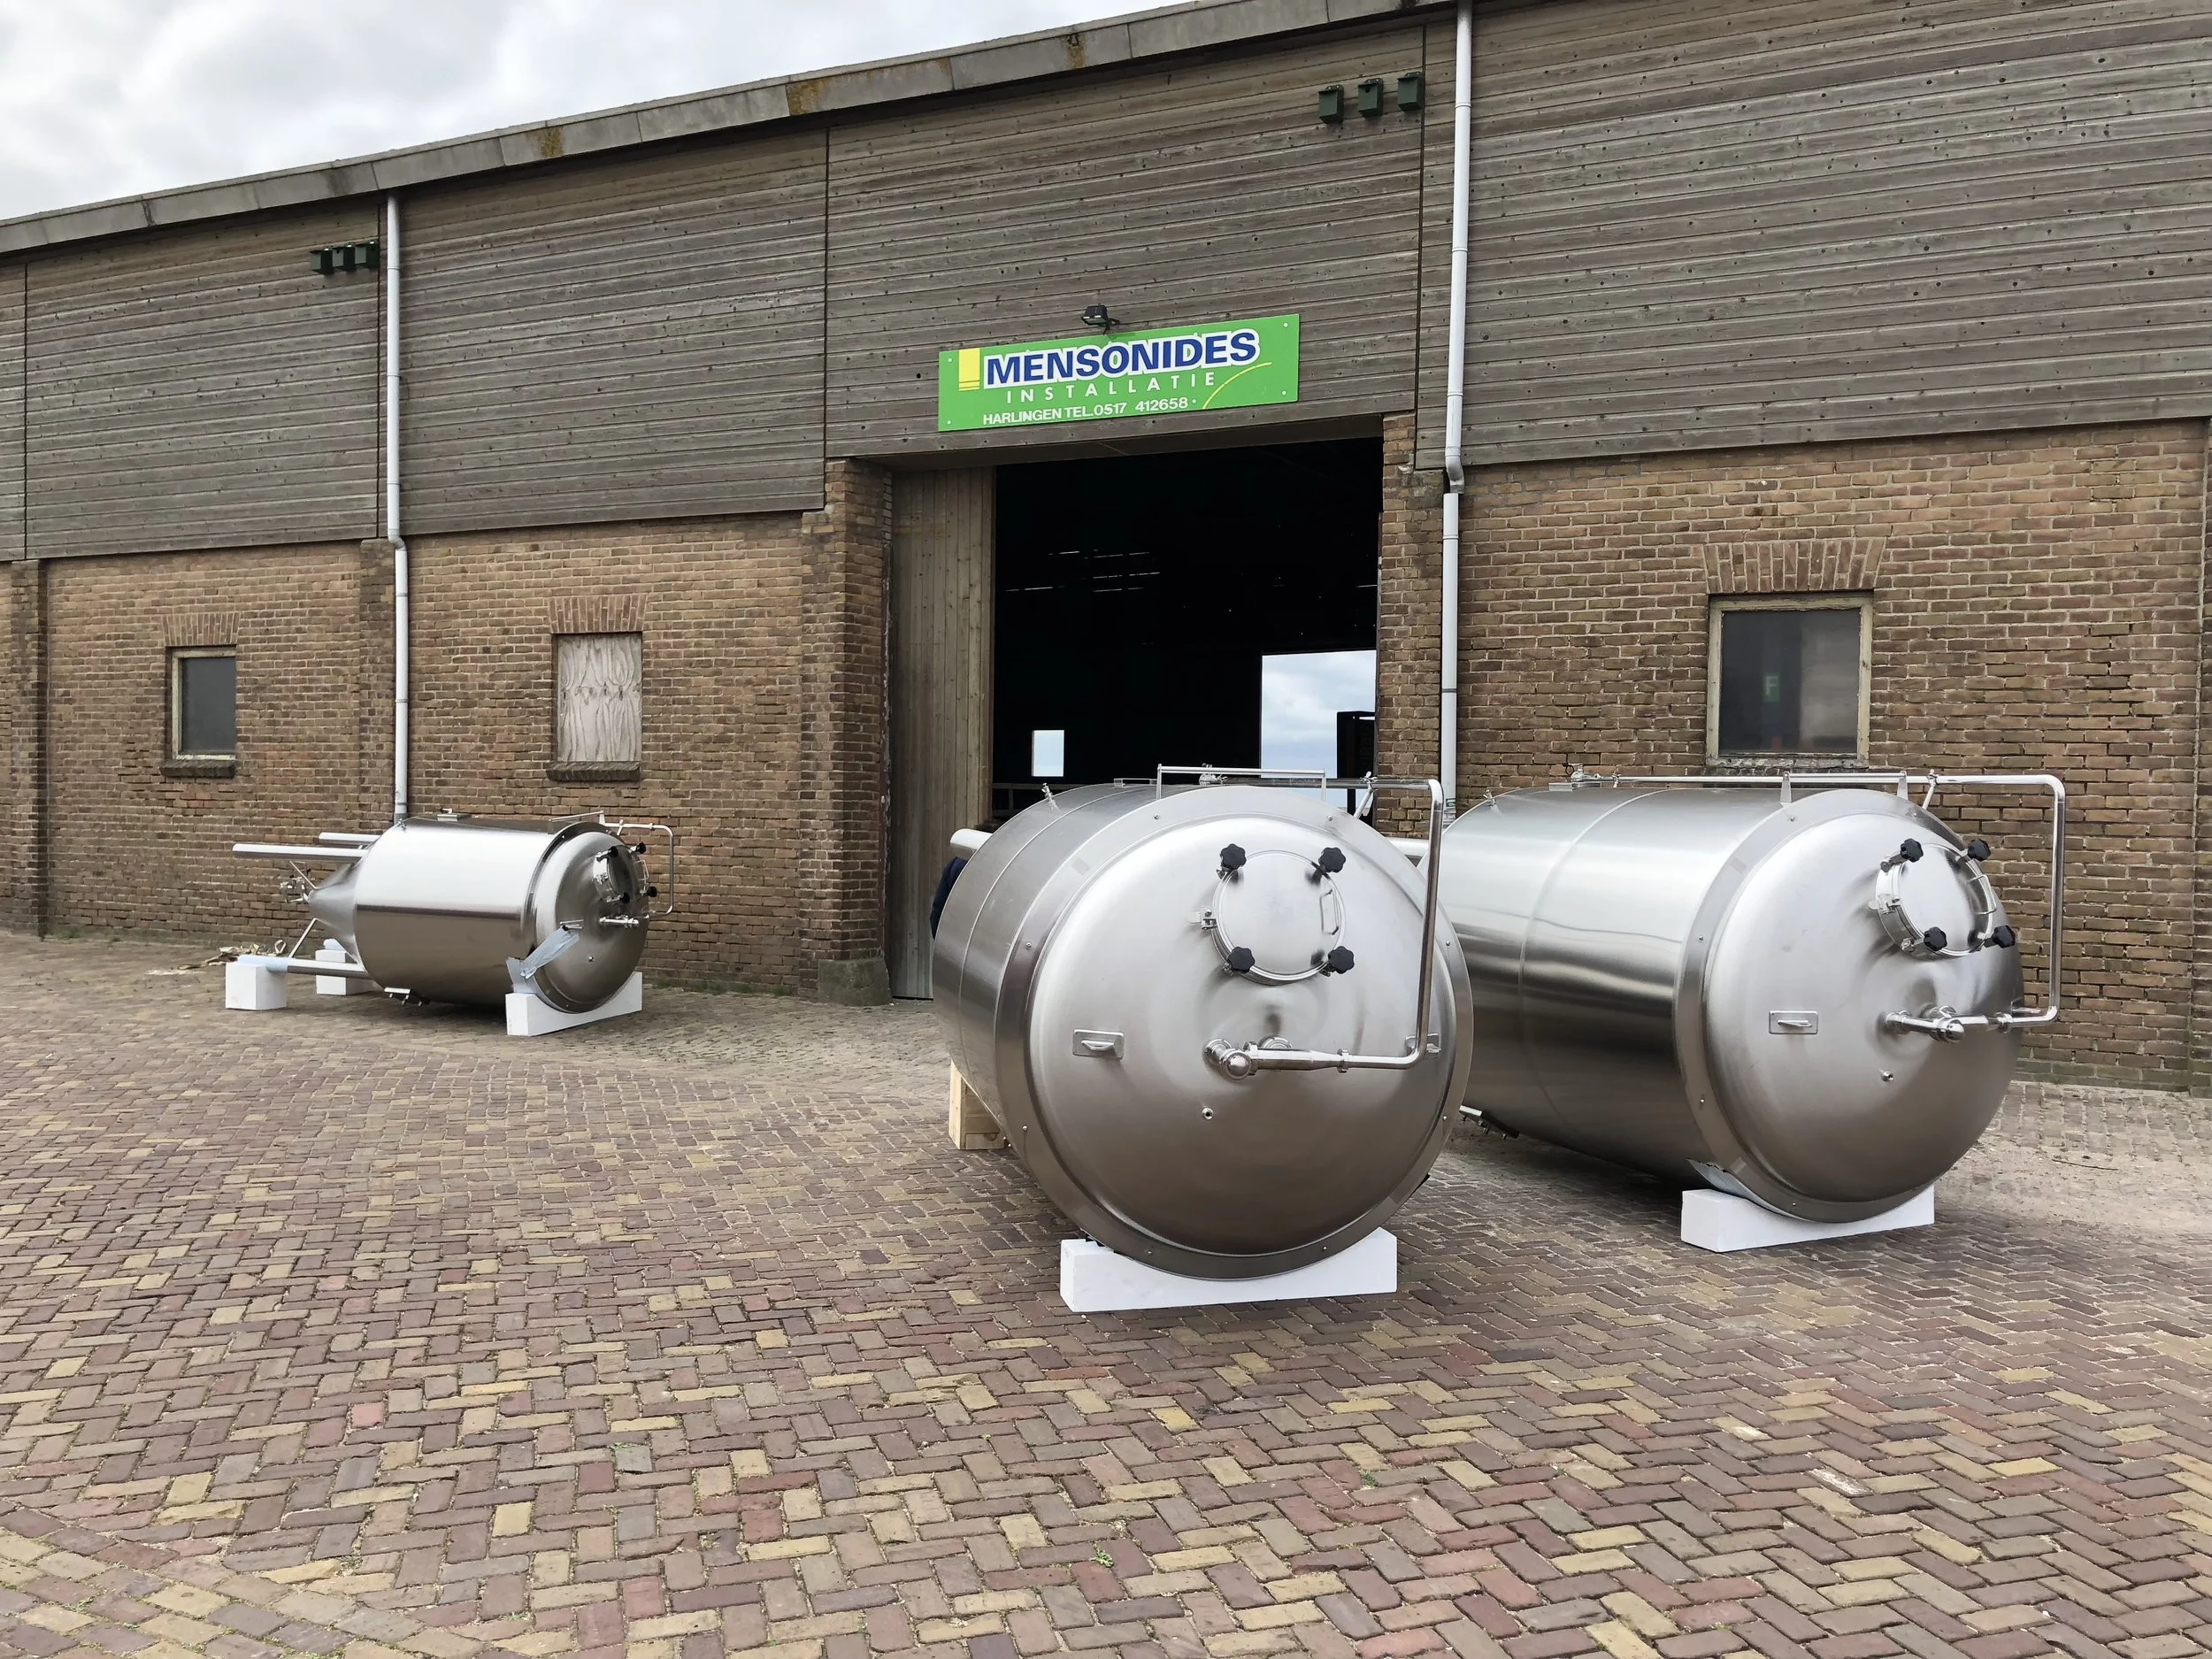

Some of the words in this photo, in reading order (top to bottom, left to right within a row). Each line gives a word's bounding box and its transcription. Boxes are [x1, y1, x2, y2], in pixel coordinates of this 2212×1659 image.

[987, 331, 1257, 386] MENSONIDES
[1006, 372, 1215, 404] INSTALLATIE
[983, 407, 1063, 426] HARLINGEN
[1134, 396, 1189, 412] 412658
